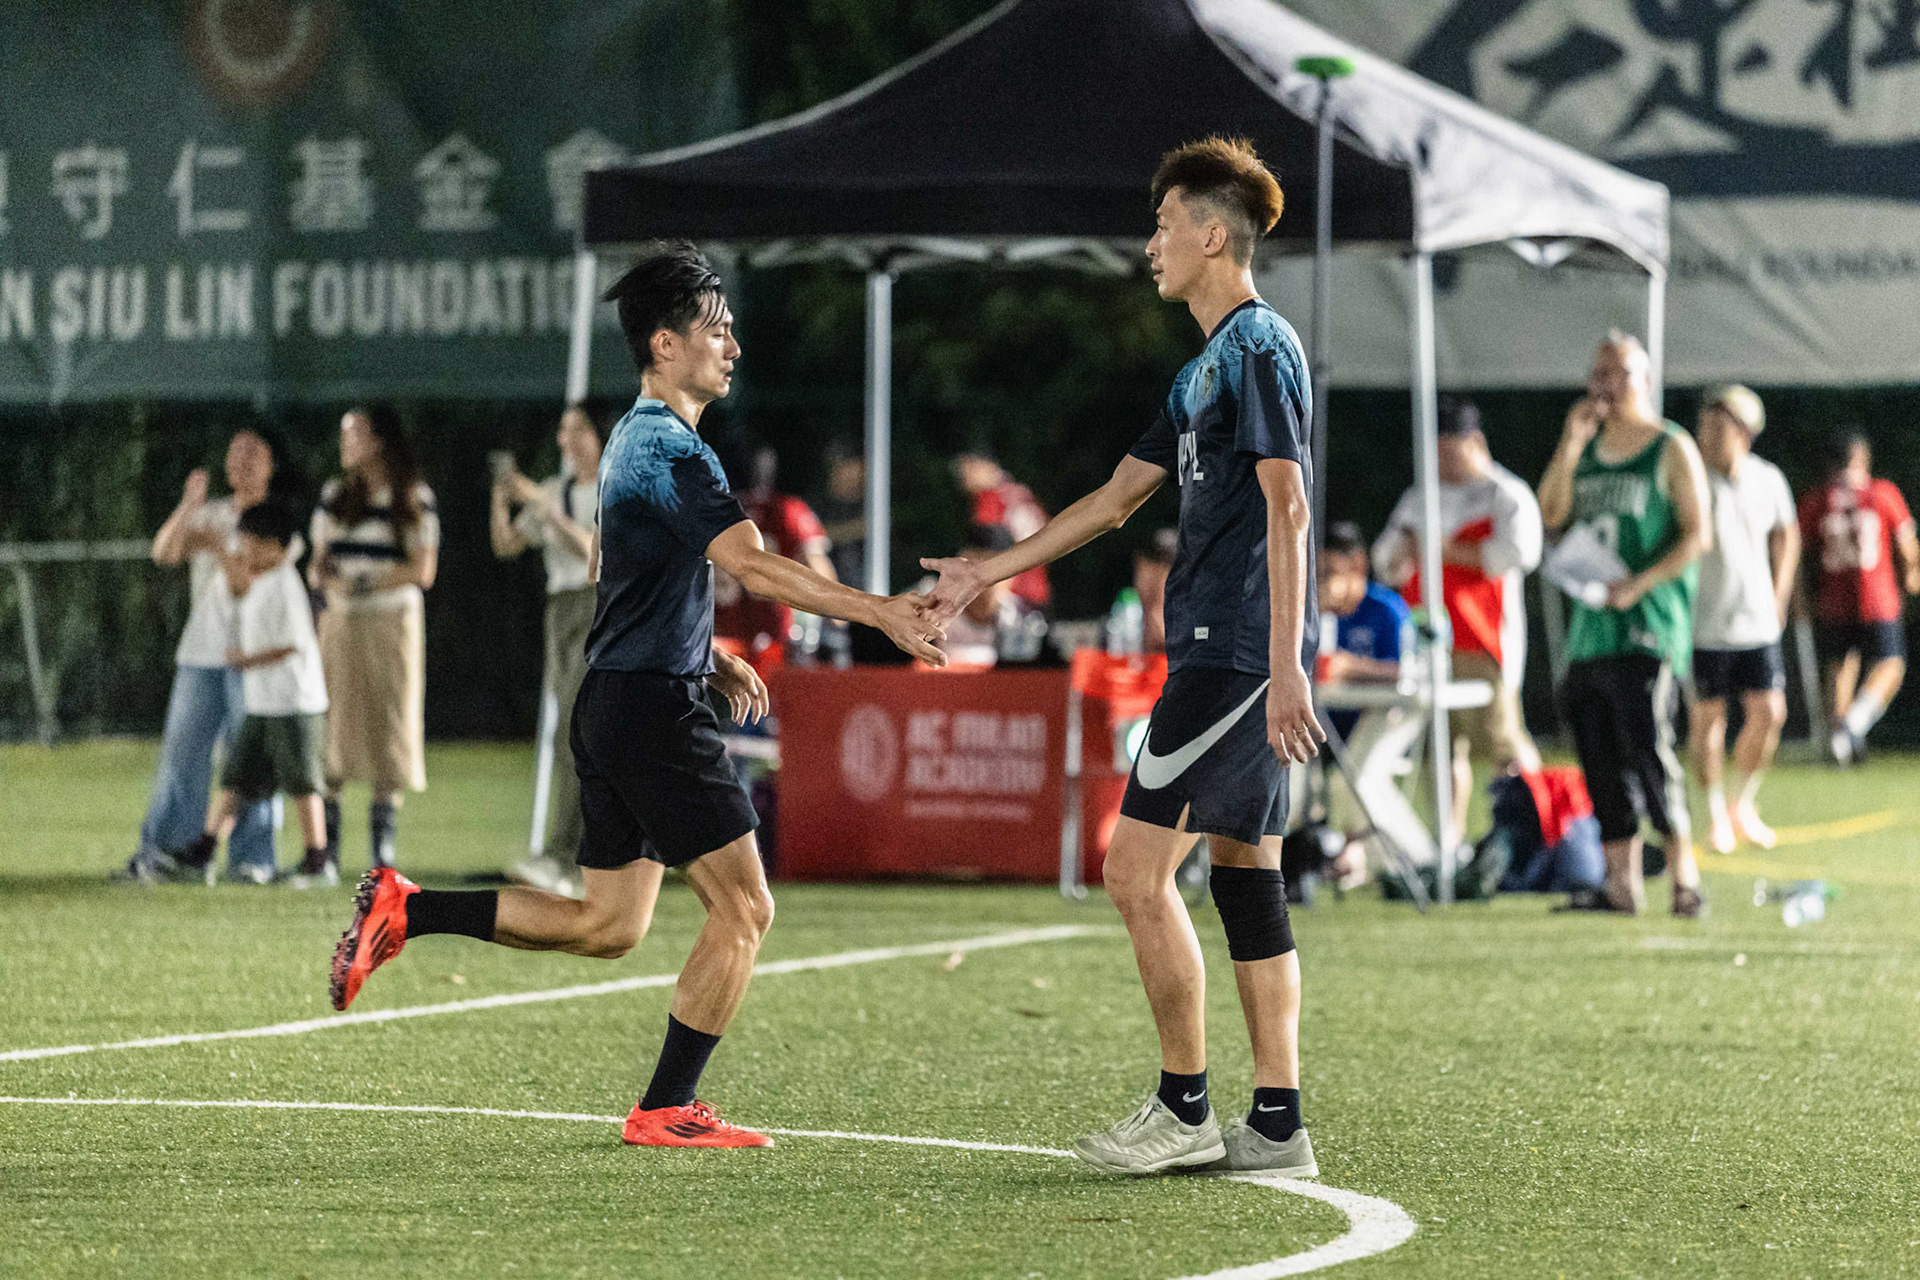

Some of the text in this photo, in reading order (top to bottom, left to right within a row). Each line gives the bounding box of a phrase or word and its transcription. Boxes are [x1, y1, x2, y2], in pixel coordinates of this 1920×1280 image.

[0, 129, 630, 239] 守仁基金會
[50, 265, 147, 342] SIU
[164, 263, 254, 341] LIN
